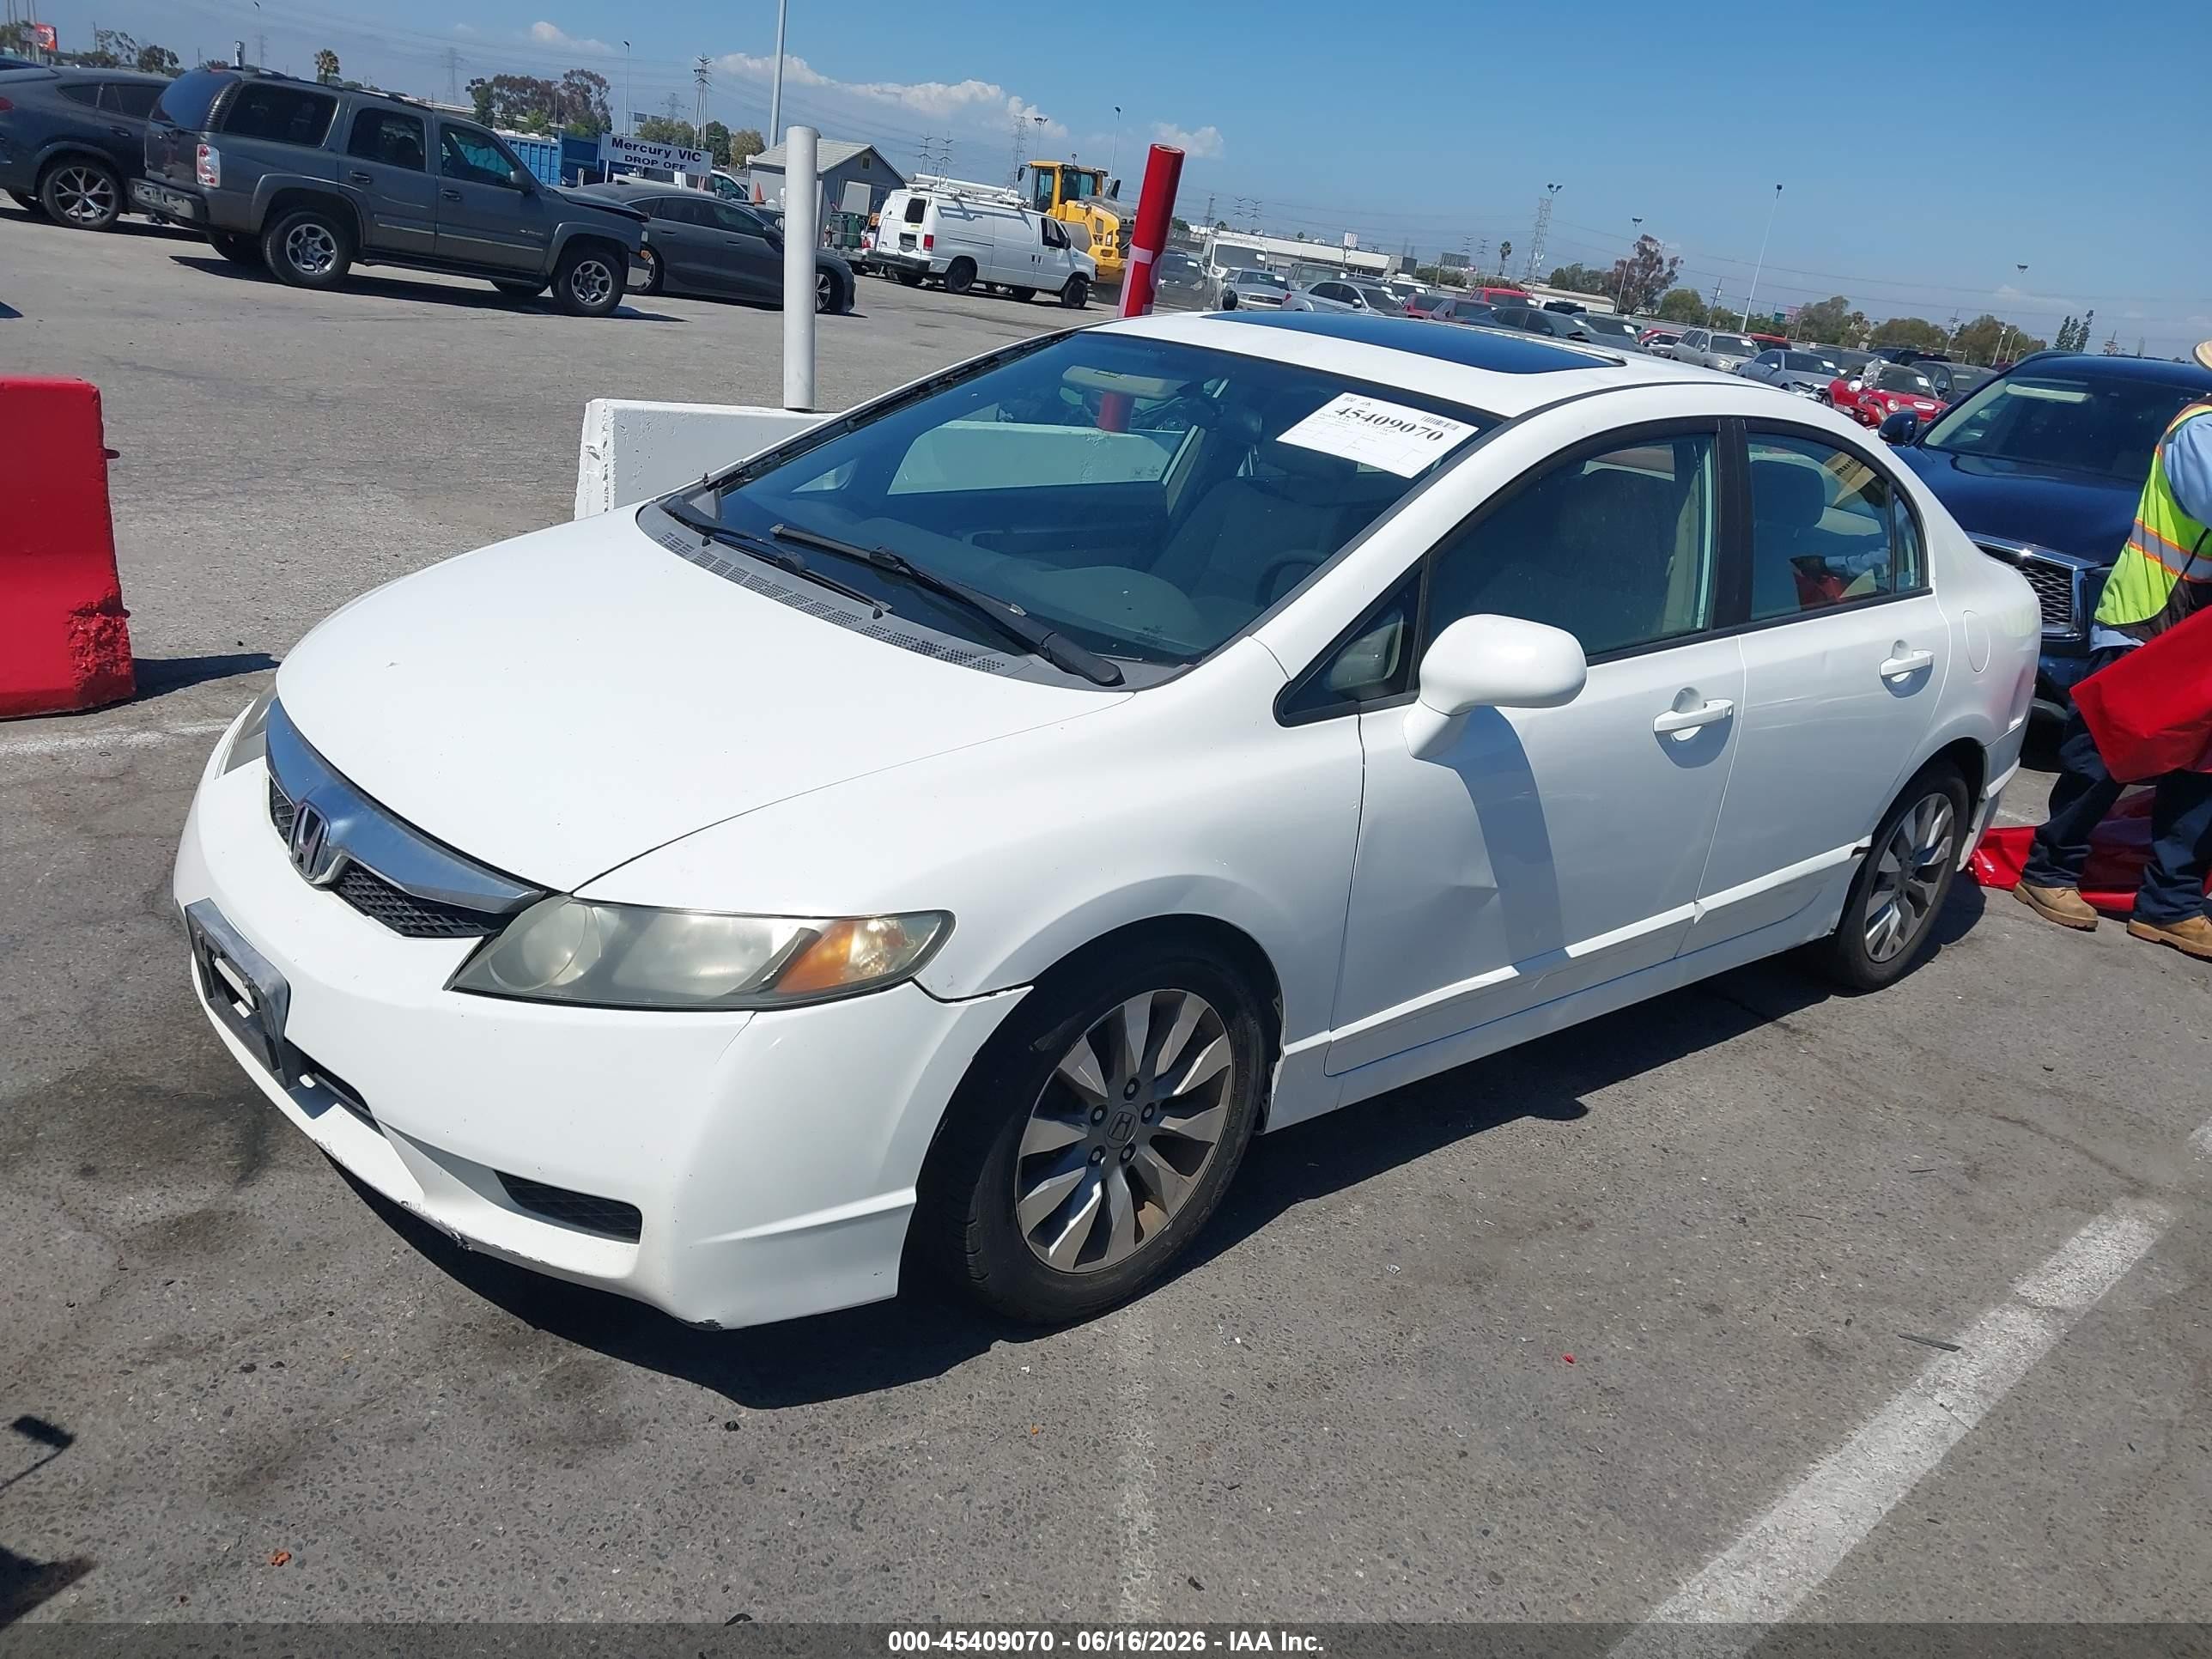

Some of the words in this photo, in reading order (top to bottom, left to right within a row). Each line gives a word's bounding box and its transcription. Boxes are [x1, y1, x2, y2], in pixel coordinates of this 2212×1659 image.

[611, 137, 672, 159] Mercury
[678, 149, 702, 162] VIC
[624, 155, 659, 166] DROP
[663, 161, 688, 171] OFF
[1334, 407, 1444, 441] 45409070
